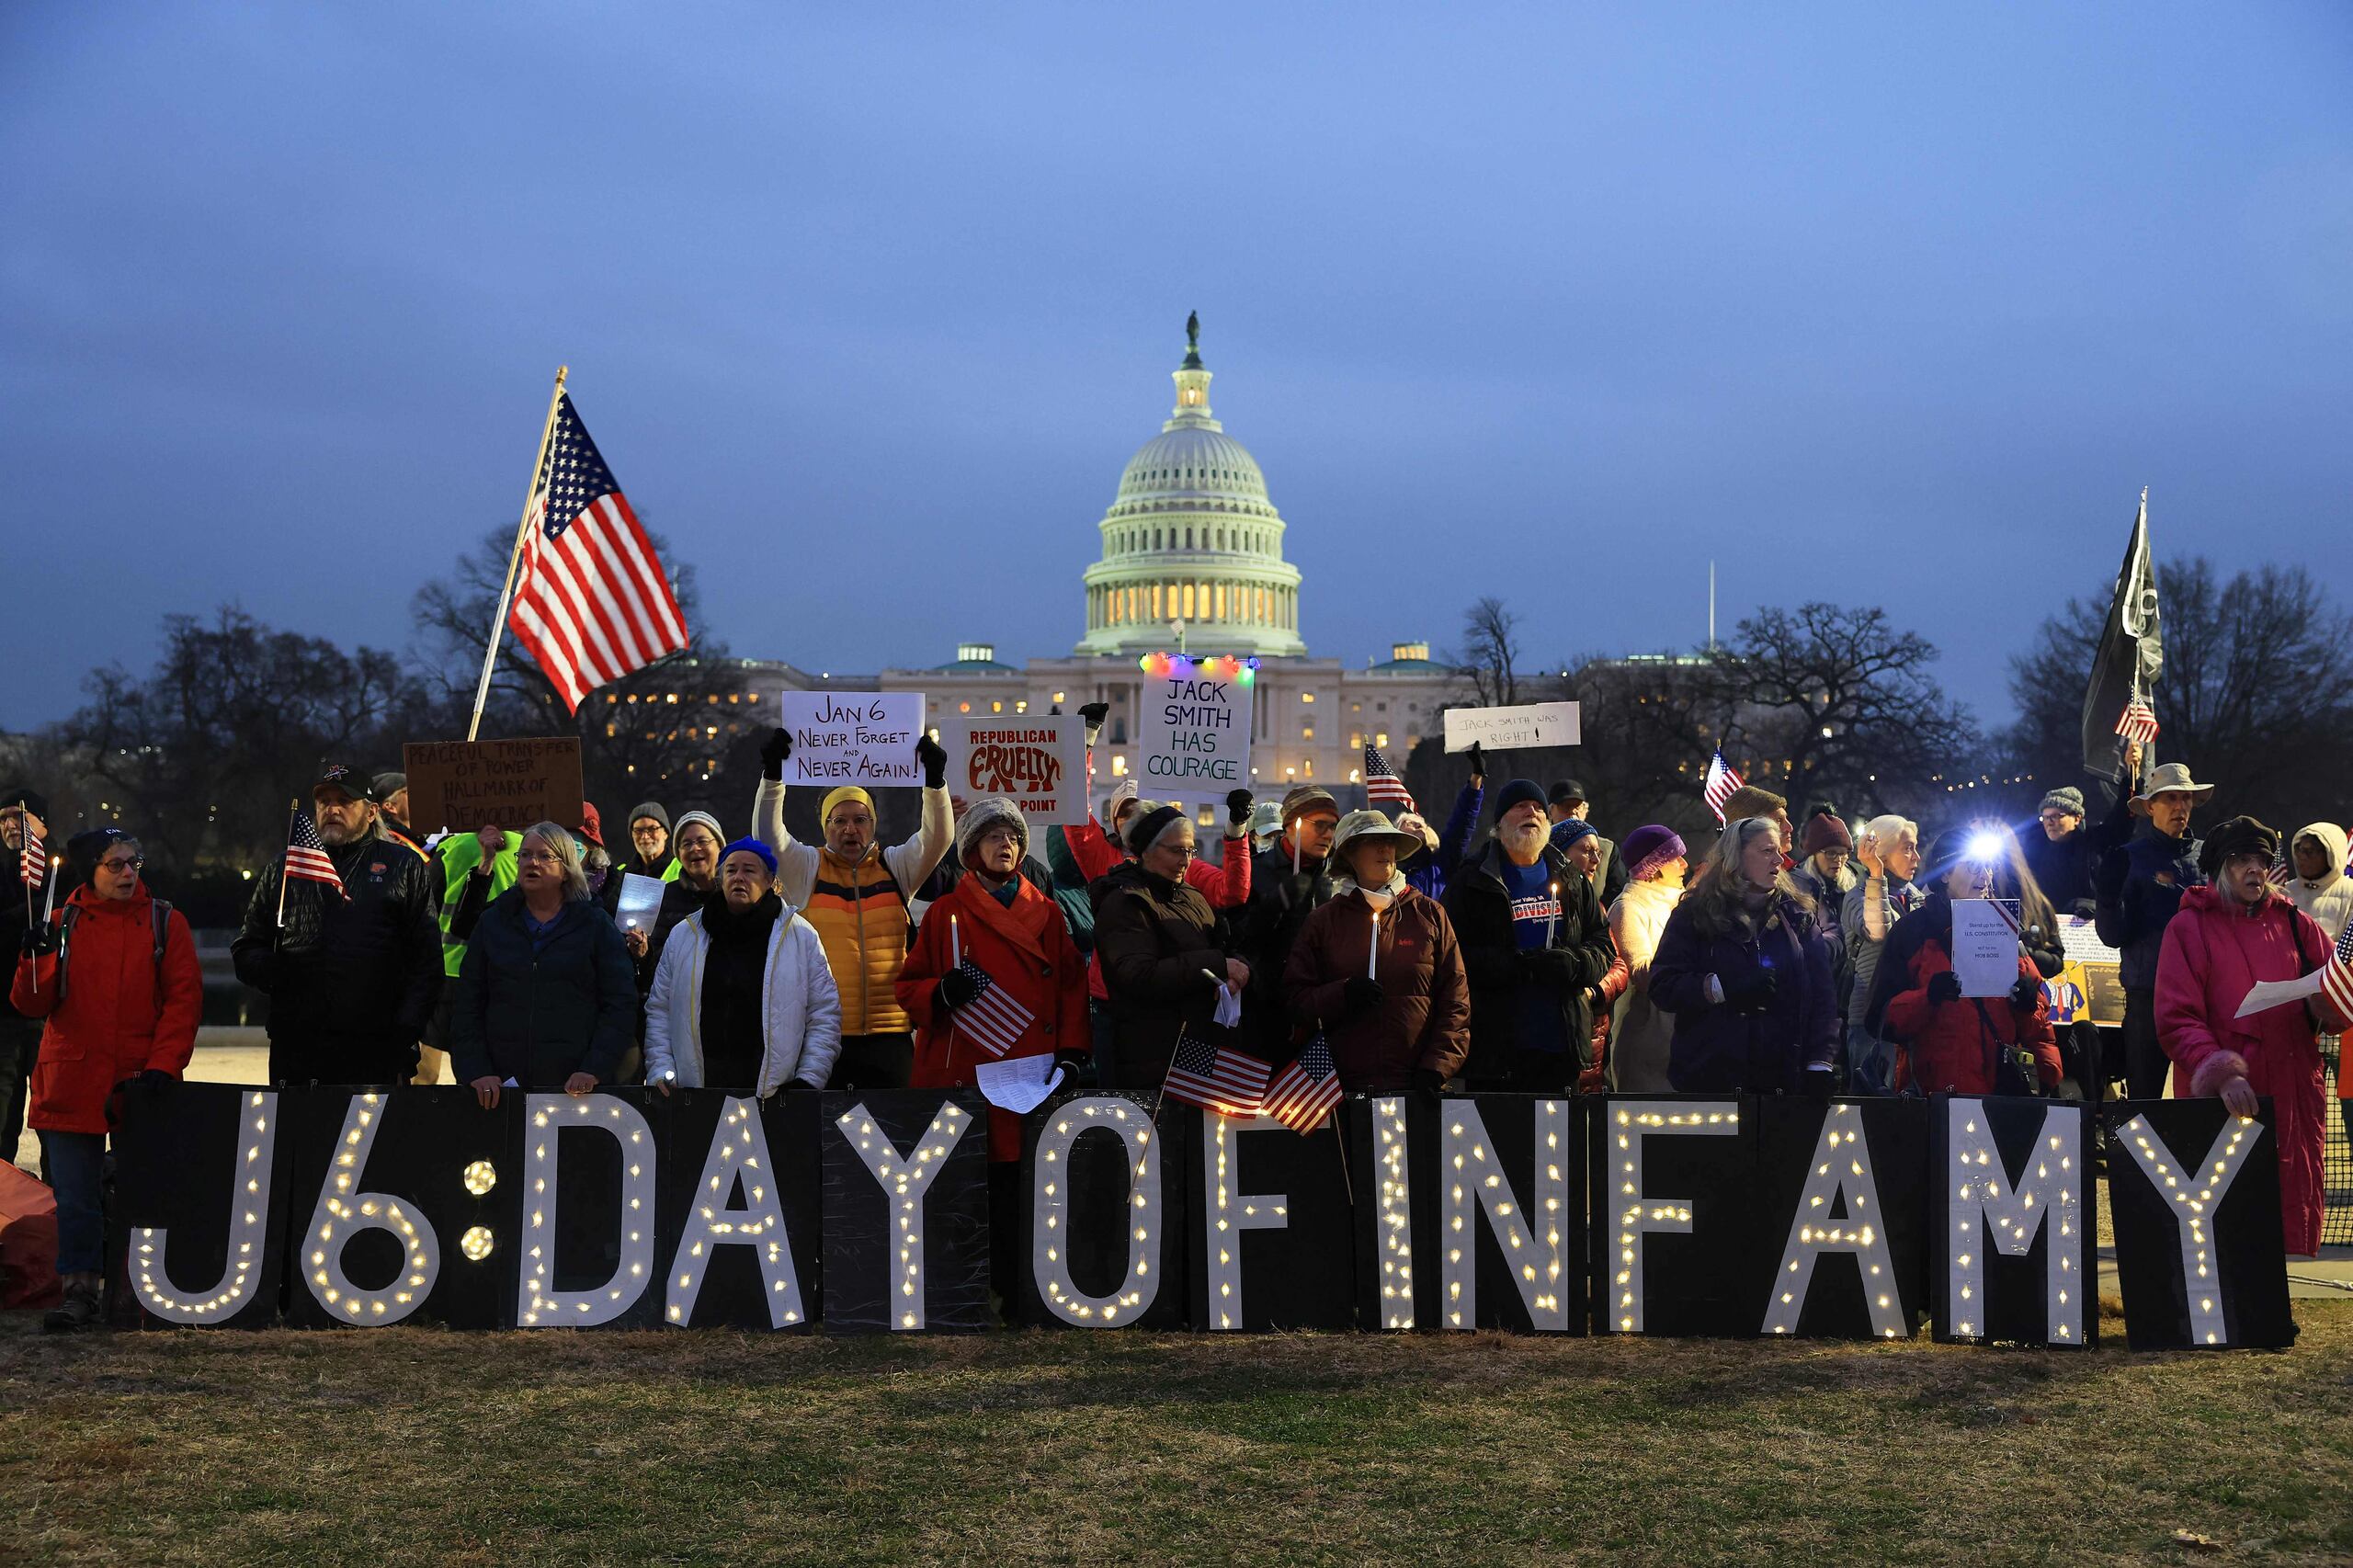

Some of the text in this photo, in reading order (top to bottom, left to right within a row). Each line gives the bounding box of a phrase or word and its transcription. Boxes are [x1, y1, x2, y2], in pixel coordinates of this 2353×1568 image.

[1167, 679, 1228, 703] JACK
[870, 699, 885, 720] 6
[1164, 705, 1232, 728] SMITH
[1459, 714, 1559, 731] JACK SMITH WAS
[798, 726, 909, 748] NEVER FORGET
[970, 730, 1057, 744] REPUBLICAN
[1172, 731, 1216, 752] HAS
[409, 741, 574, 765] PEACEFUL TRANSFER
[843, 749, 858, 757] AND
[456, 760, 535, 777] OF POWER
[798, 757, 851, 779] NEVER
[969, 744, 1061, 792] CRUELTY
[1147, 755, 1238, 780] COURAGE
[443, 778, 548, 801] HALLMARK OF
[446, 803, 546, 828] DEMOCRACY
[1020, 800, 1057, 812] POINT
[517, 1094, 972, 1331] DAY
[1033, 1096, 1330, 1331] OF
[1371, 1096, 2265, 1345] INFAMY
